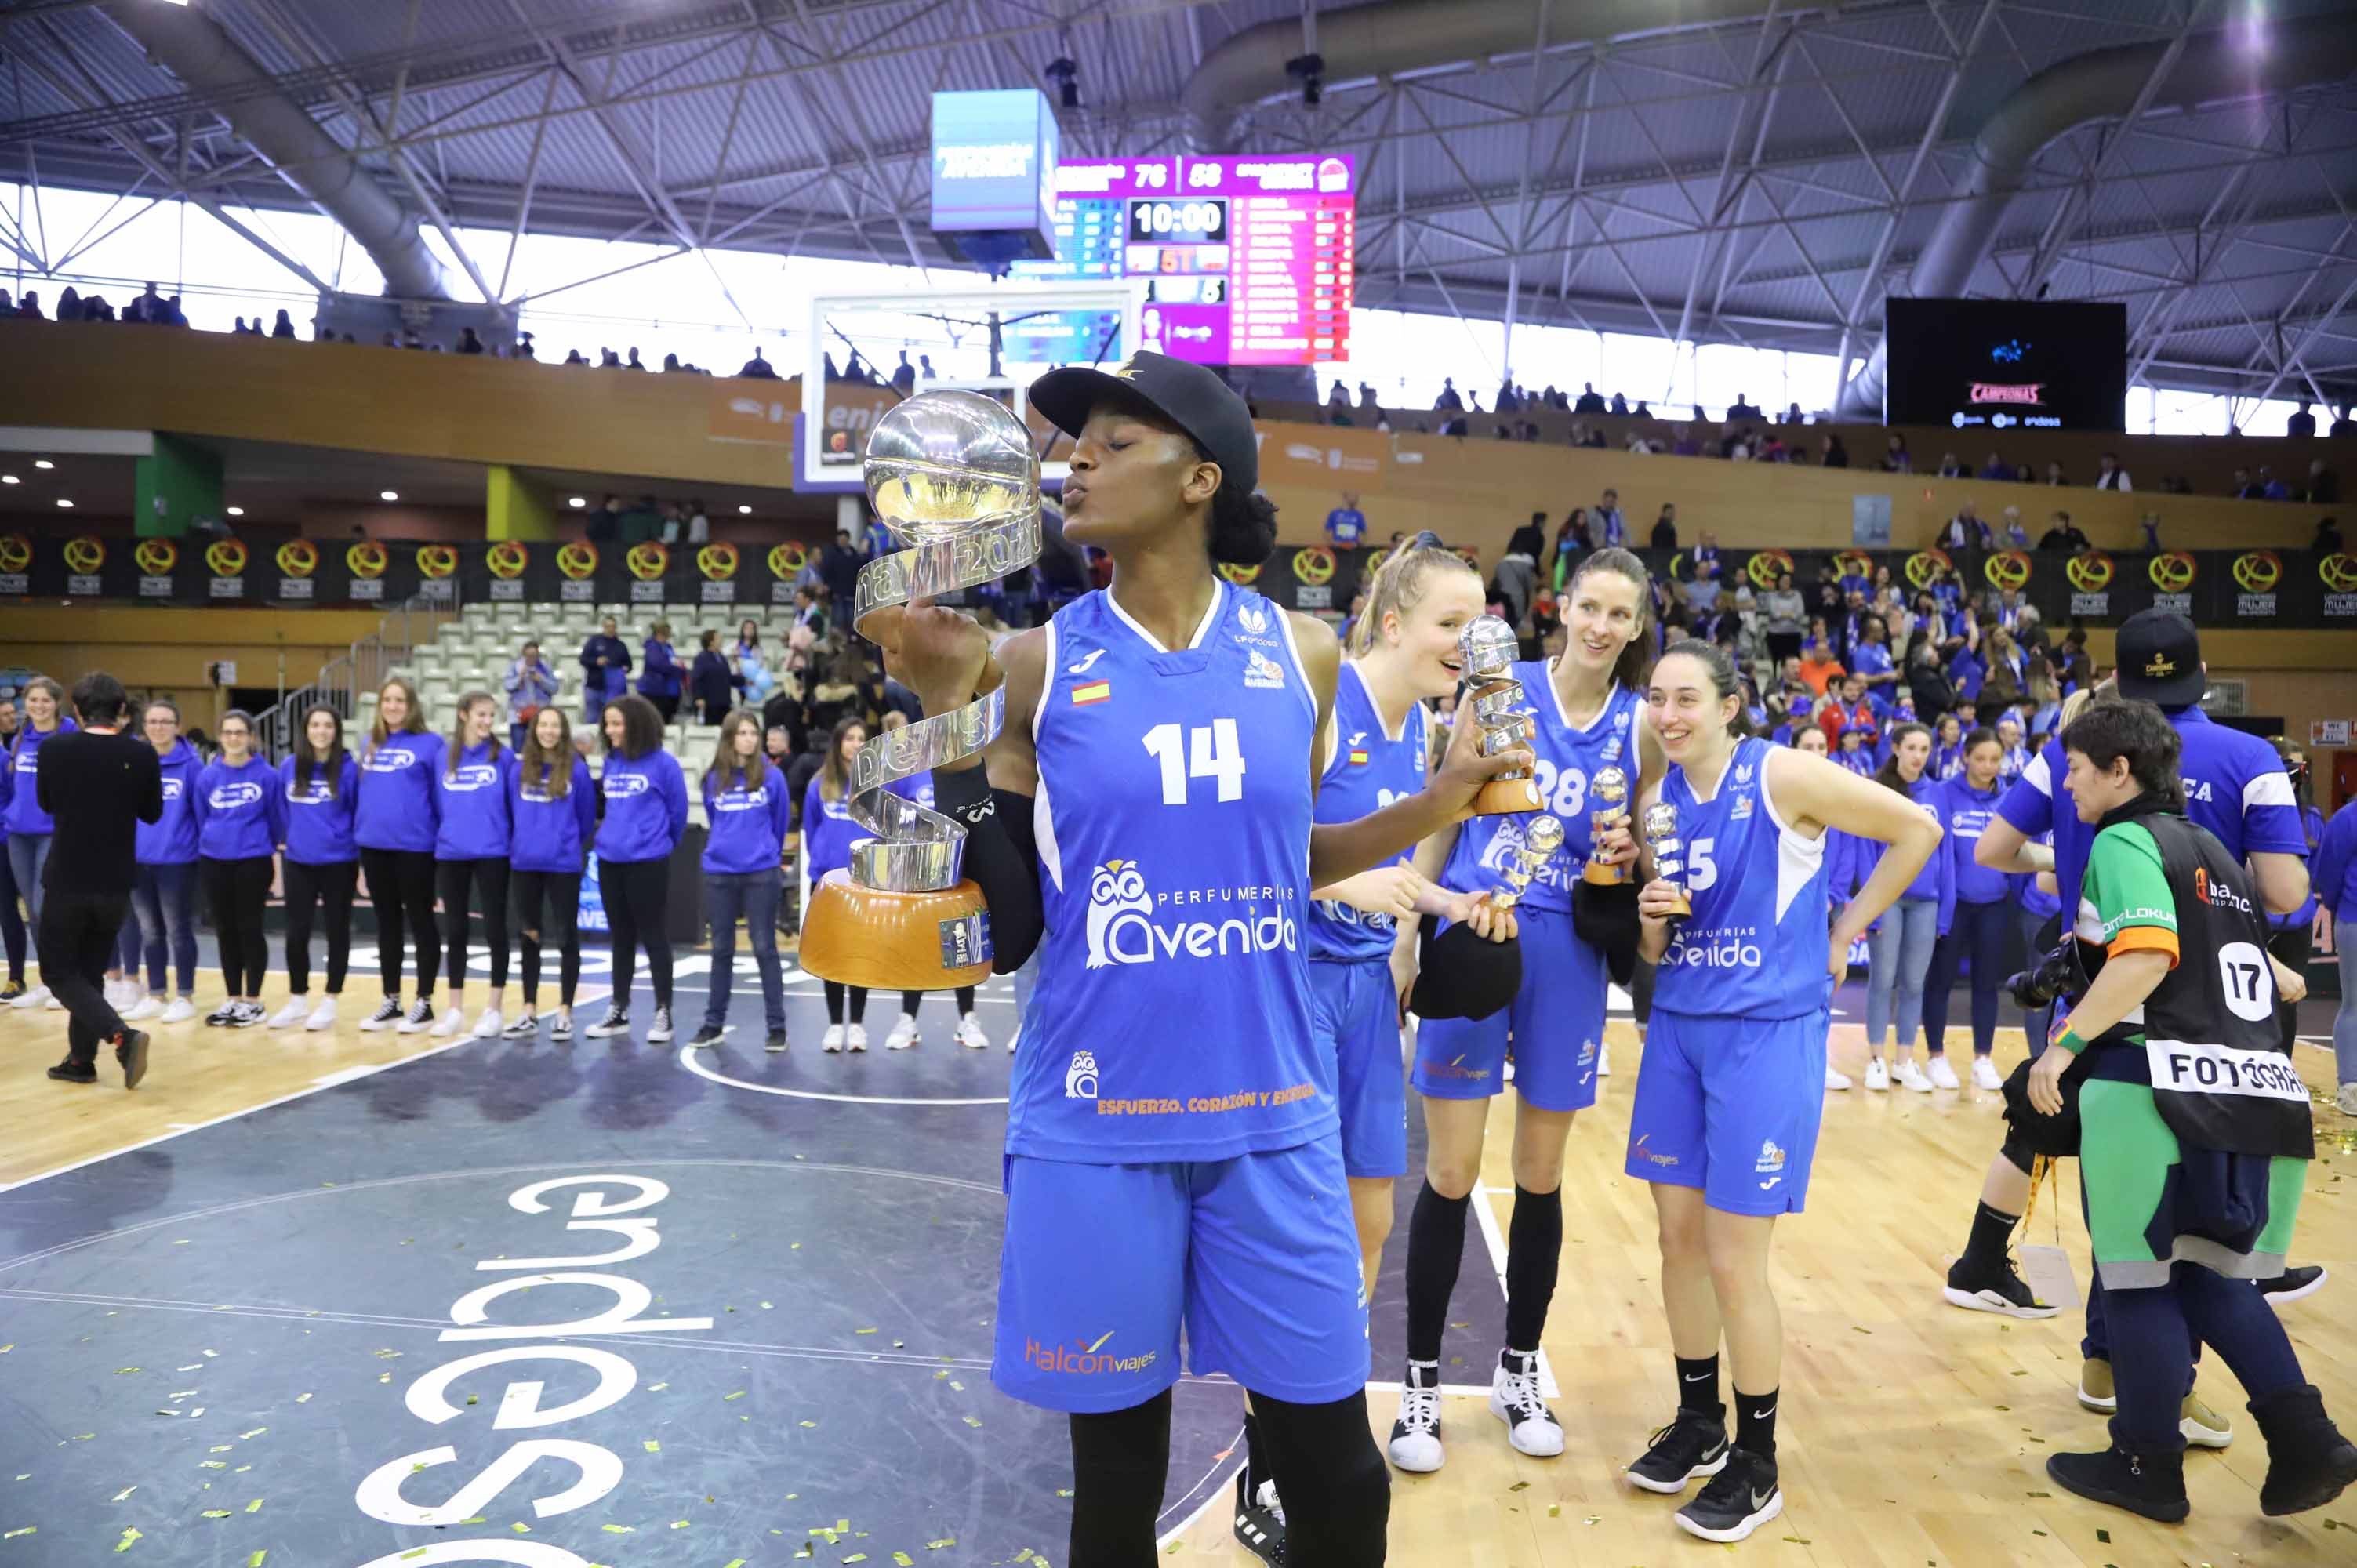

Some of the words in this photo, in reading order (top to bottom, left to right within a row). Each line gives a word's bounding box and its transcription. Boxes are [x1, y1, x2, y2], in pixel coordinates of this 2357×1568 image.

[1135, 202, 1221, 233] 10:00
[1970, 382, 2039, 403] CAMPEONAS
[1142, 718, 1246, 804] 14
[1533, 760, 1587, 817] 28
[1108, 903, 1296, 964] avenida
[2227, 961, 2261, 1002] 17
[1098, 1098, 1184, 1115] ESFUERZO,
[1187, 1088, 1258, 1113] CORAZÓN
[1259, 1091, 1271, 1107] Y
